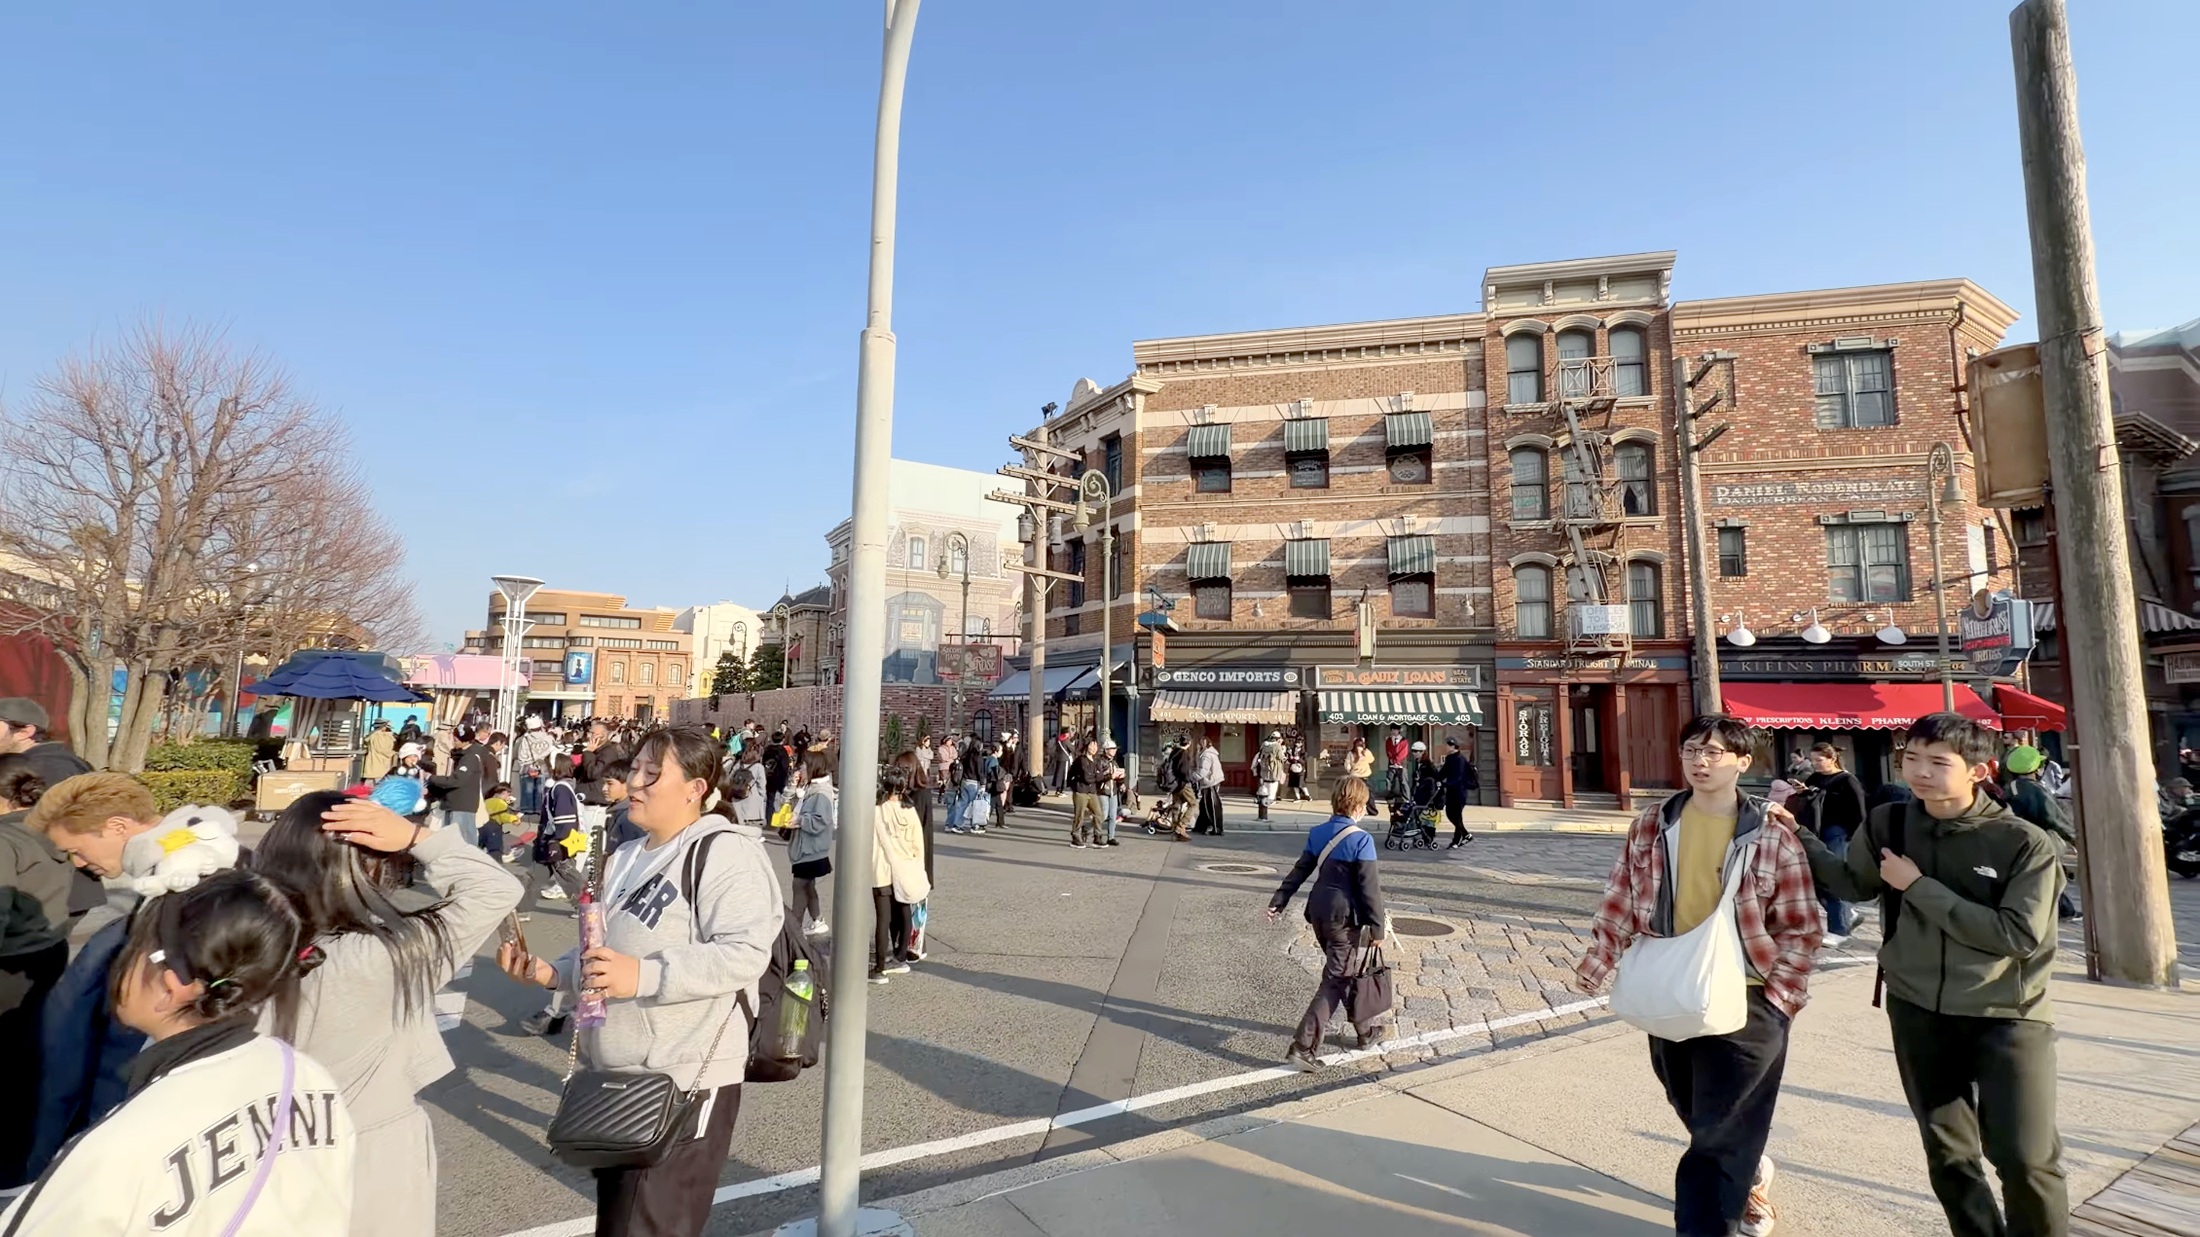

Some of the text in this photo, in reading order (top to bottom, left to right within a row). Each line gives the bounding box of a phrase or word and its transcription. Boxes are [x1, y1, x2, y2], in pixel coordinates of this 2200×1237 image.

[1716, 480, 1917, 497] DANIEL ROSENBLATT
[1836, 492, 1917, 502] GALLERY
[1586, 606, 1624, 615] OFFICES
[1897, 660, 1924, 668] SOUTH
[1173, 671, 1216, 682] GENCO
[1219, 671, 1281, 682] IMPORTS
[1403, 670, 1447, 685] LOANS
[1453, 669, 1468, 677] REAL
[1450, 676, 1472, 684] ESTATE
[1189, 711, 1218, 720] GENCO
[1220, 712, 1258, 720] IMPORTS
[1328, 713, 1344, 721] 403
[1387, 713, 1427, 722] MORTGAGE
[1454, 714, 1471, 723] 403
[1819, 717, 1862, 725] KLEIN'S
[1518, 710, 1530, 757] STORAGE
[1539, 710, 1550, 757] FREIGHT
[149, 1090, 340, 1232] JENNI
